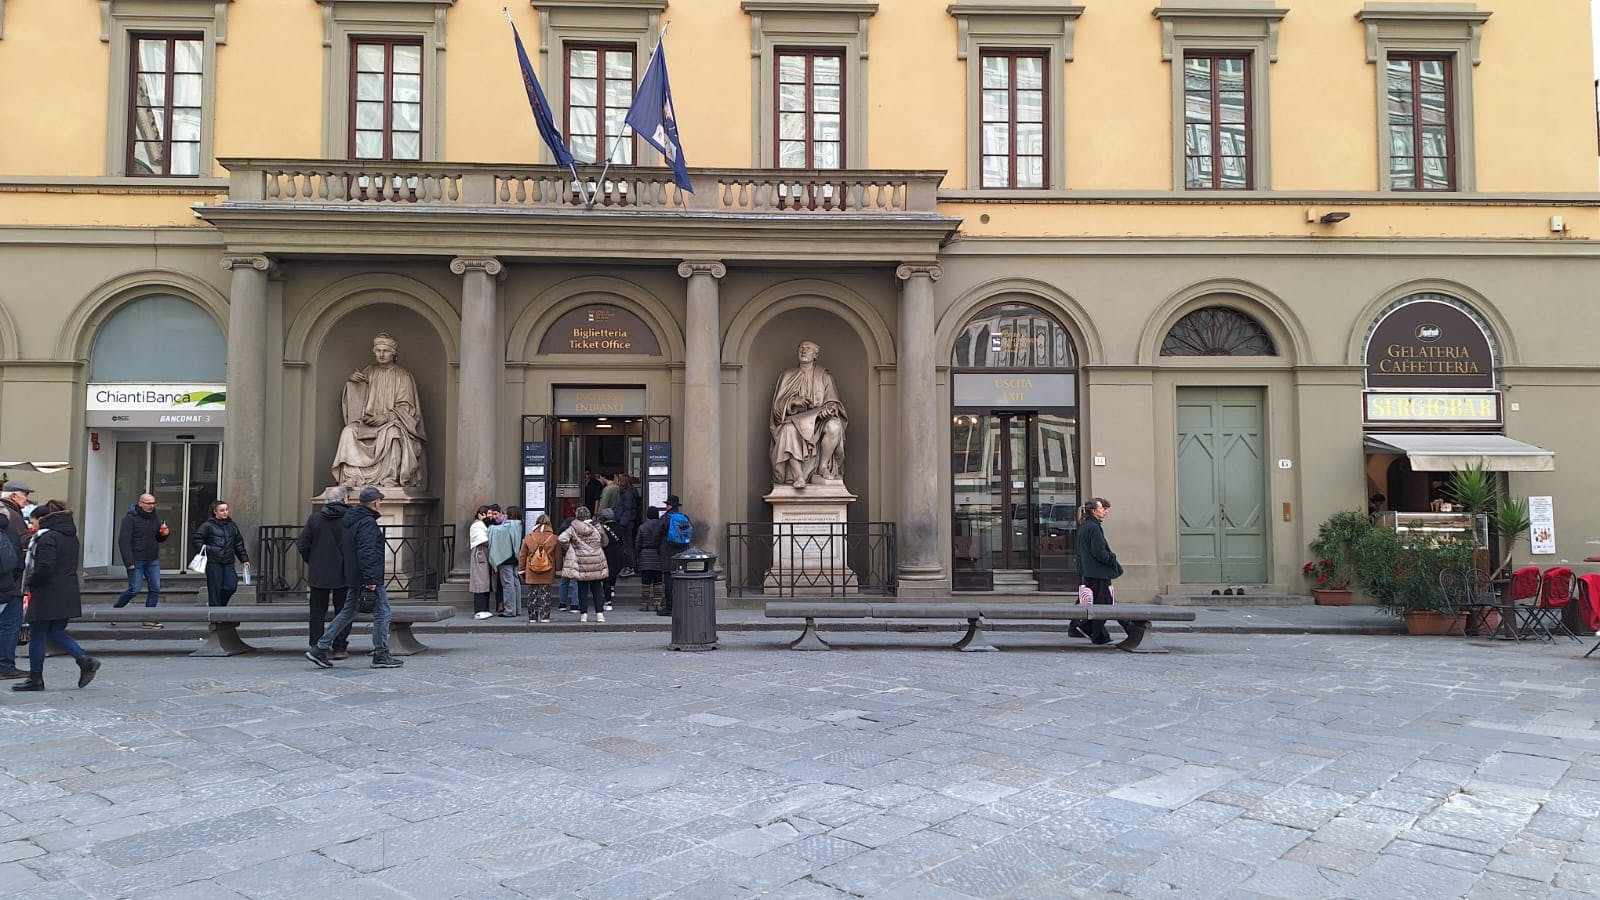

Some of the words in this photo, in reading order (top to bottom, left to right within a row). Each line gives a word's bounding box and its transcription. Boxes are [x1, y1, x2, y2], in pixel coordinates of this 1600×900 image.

[573, 328, 627, 339] Biglietteria
[569, 340, 599, 349] Ticket
[601, 340, 631, 349] Office
[994, 379, 1033, 389] USCITA
[1003, 392, 1025, 401] EXIT
[1372, 397, 1492, 417] SERGIOBAR
[159, 415, 202, 423] BANCOMAT
